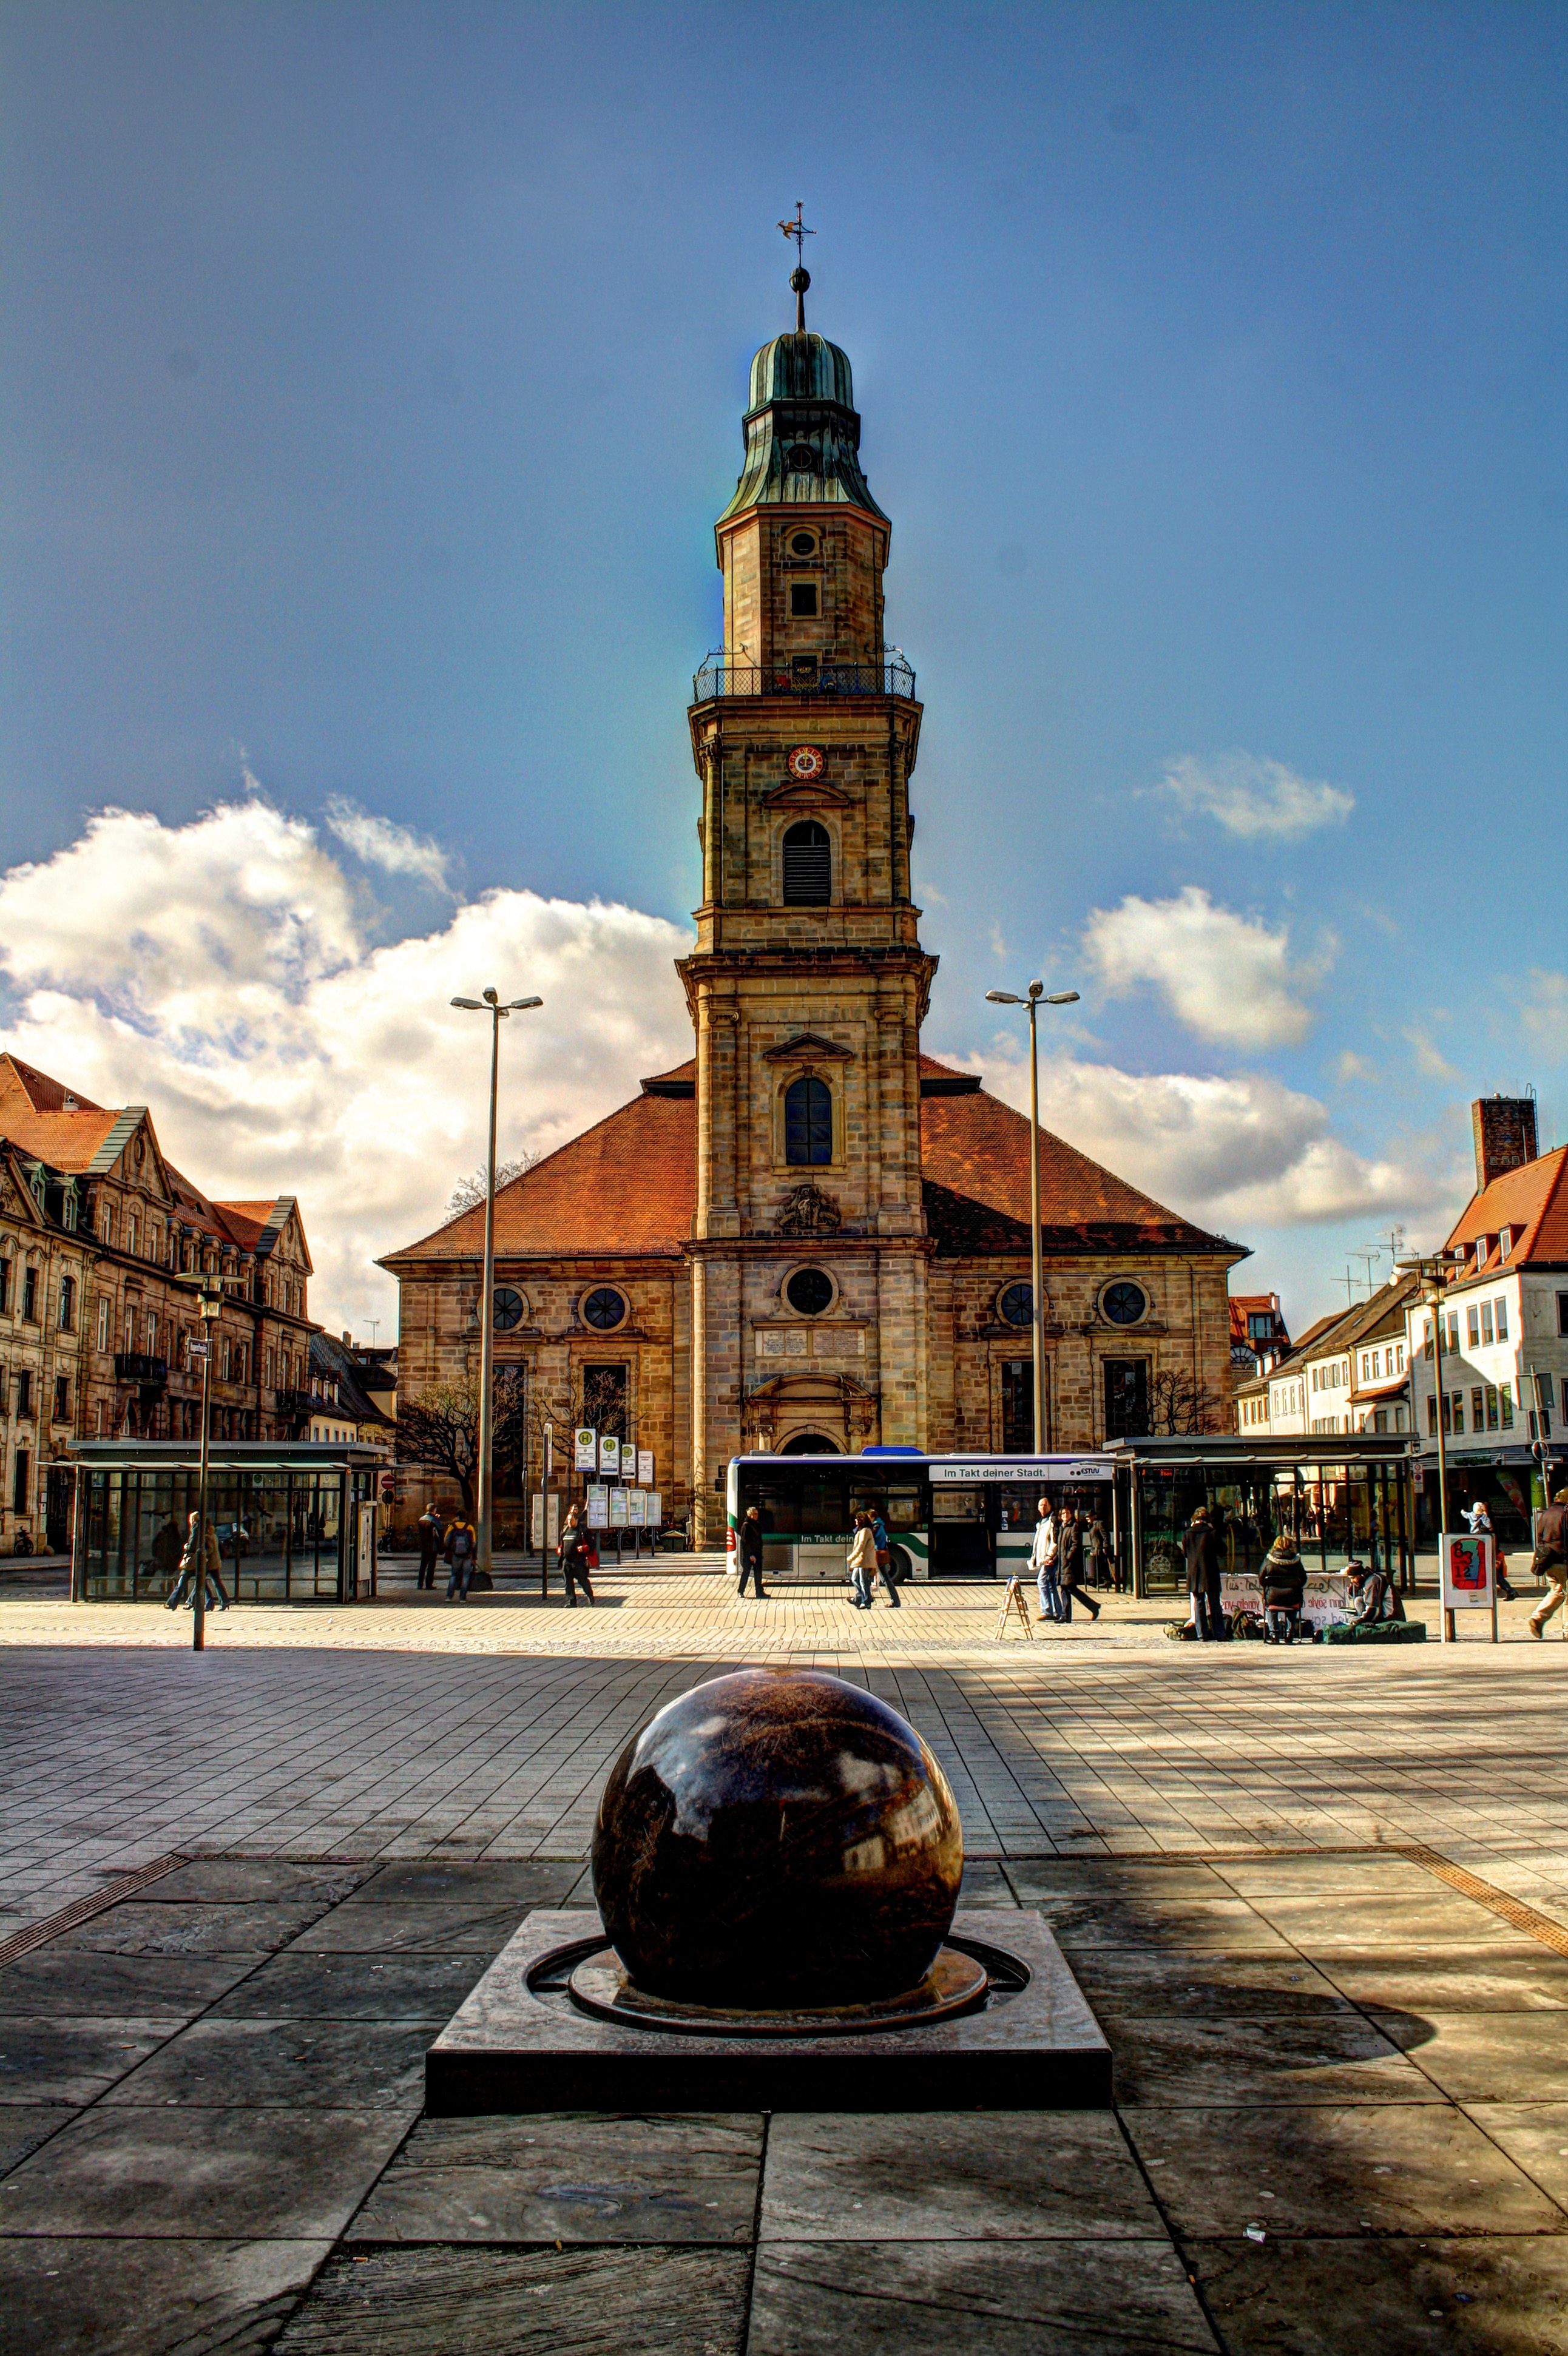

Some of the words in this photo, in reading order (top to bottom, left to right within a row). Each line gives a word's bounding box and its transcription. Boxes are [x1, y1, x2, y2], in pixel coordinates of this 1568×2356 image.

[944, 1468, 956, 1477] Im
[959, 1468, 981, 1477] Takt
[982, 1468, 1015, 1477] deiner
[1016, 1468, 1046, 1477] Stadt.
[814, 1534, 833, 1543] Takt
[835, 1534, 854, 1543] dein
[1455, 1565, 1471, 1578] 12
